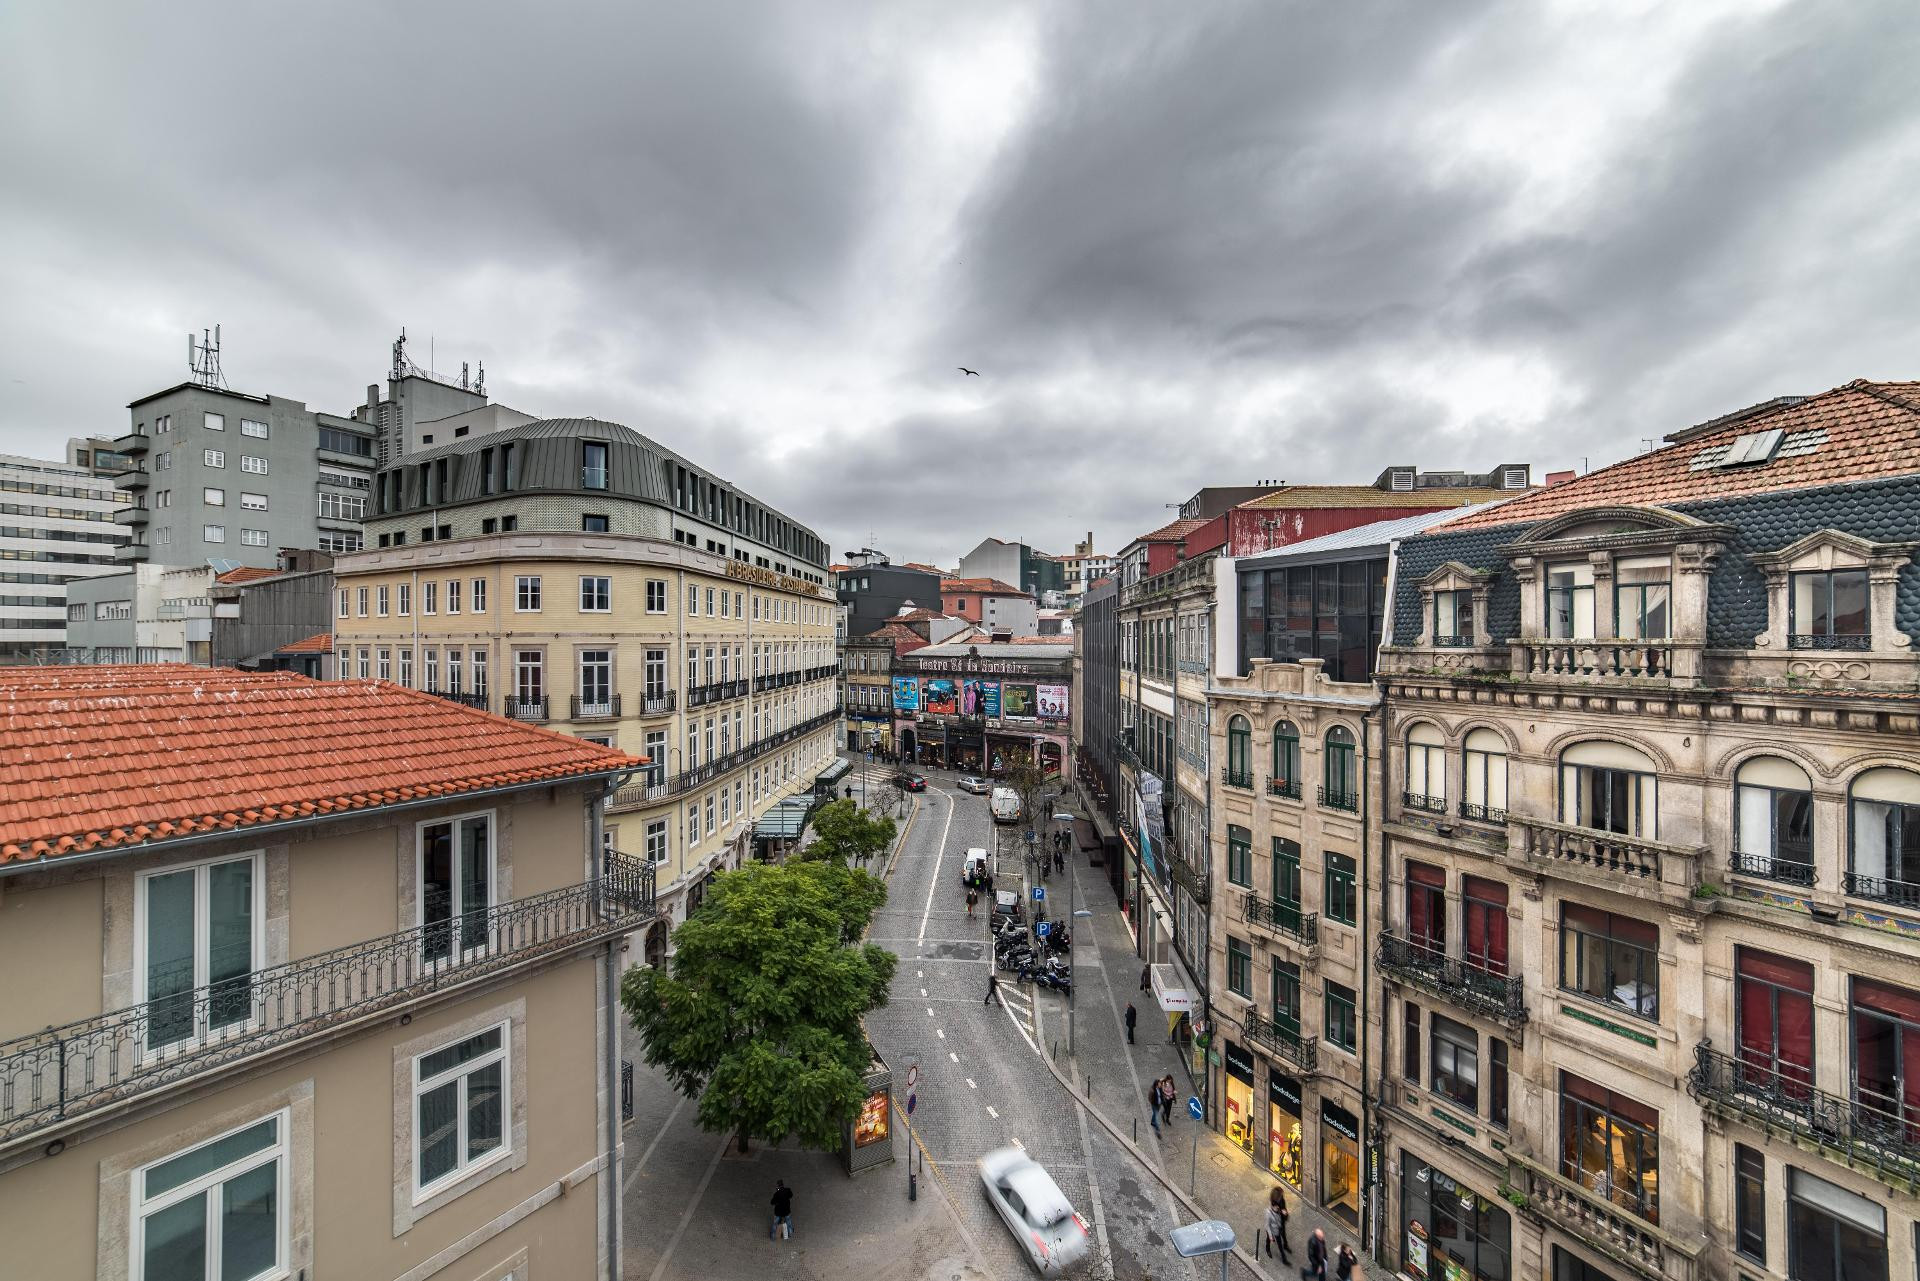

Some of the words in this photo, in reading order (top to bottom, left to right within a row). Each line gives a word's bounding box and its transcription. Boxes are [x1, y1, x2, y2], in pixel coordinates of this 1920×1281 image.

[736, 562, 777, 587] BRASILEIRA
[919, 658, 948, 671] Teatro
[967, 659, 978, 671] da
[981, 660, 1029, 673] Bandeira
[1272, 1082, 1301, 1104] backstage
[1323, 1113, 1357, 1139] backstage
